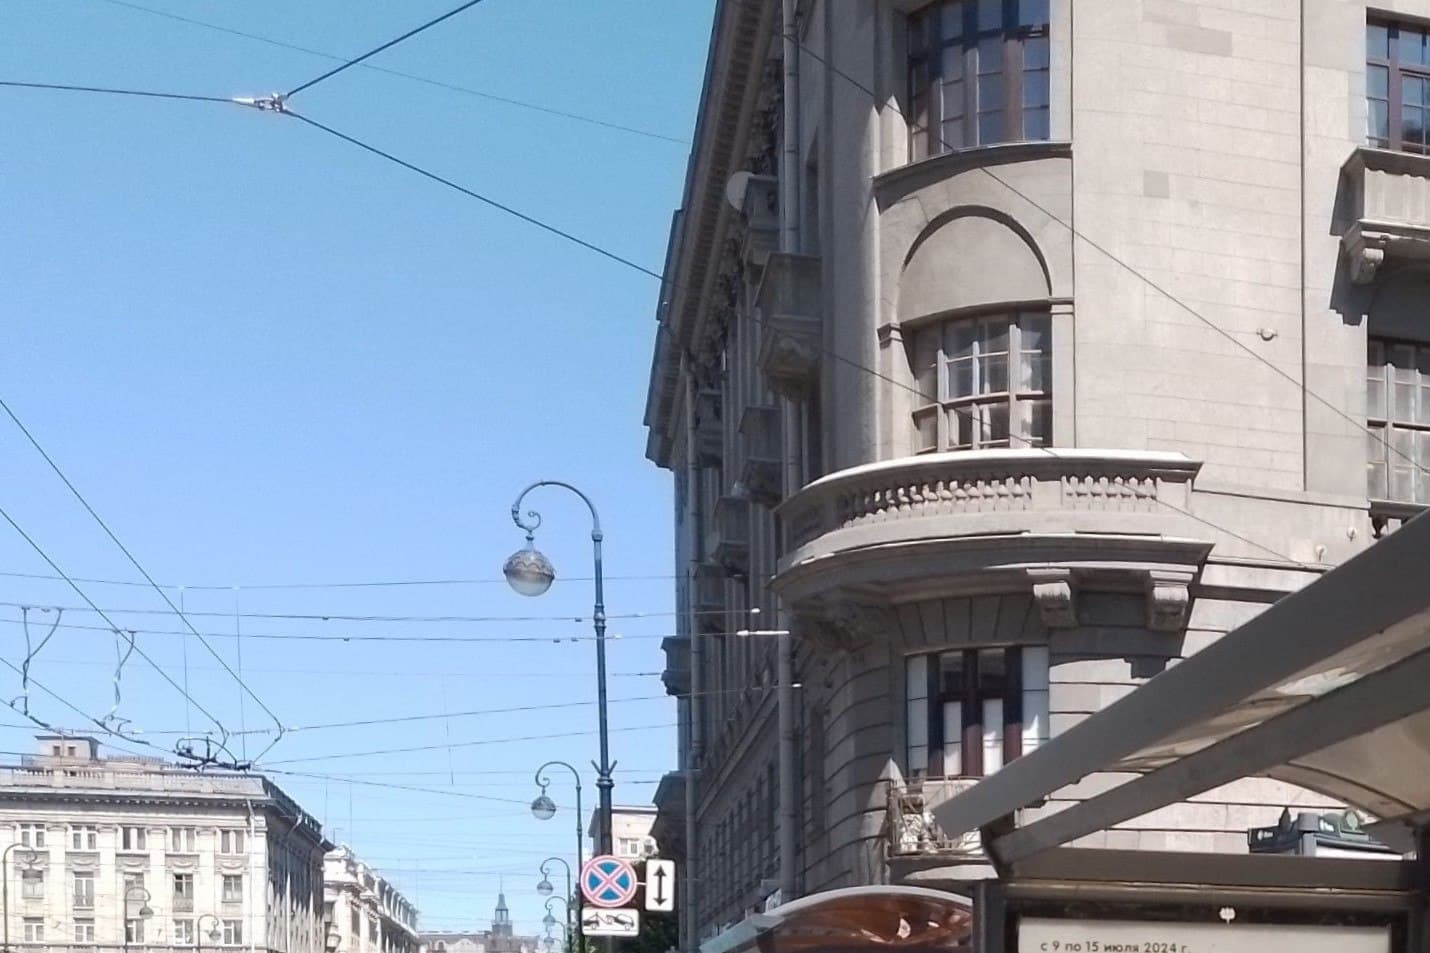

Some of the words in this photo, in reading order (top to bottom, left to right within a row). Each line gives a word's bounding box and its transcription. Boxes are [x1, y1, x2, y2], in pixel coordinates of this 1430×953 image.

[1040, 943, 1048, 952] с
[1052, 941, 1060, 951] 9
[1065, 943, 1082, 953] по
[1085, 941, 1099, 952] 15
[1103, 944, 1140, 953] июля
[1143, 942, 1177, 953] 2024
